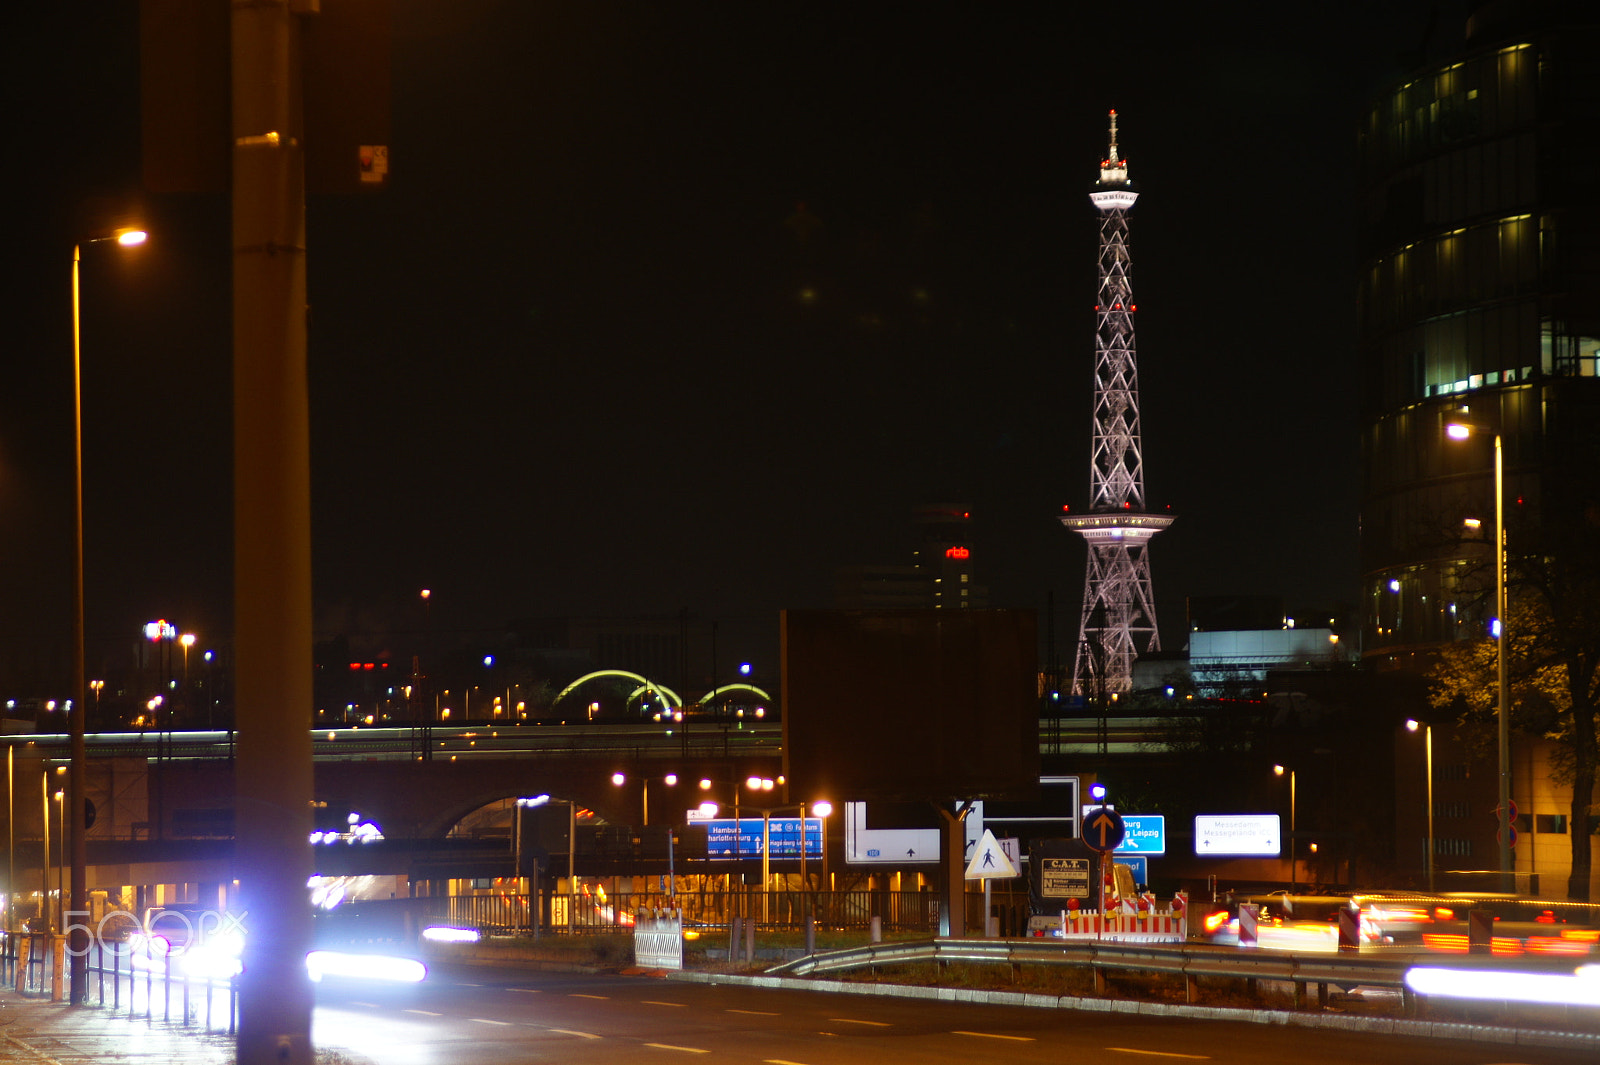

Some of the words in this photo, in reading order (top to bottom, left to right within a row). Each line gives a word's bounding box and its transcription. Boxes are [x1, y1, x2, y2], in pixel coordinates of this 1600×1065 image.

[946, 546, 969, 559] rbb
[1123, 820, 1141, 829] burg
[1214, 821, 1261, 829] Messedamm
[1132, 829, 1160, 838] Leipzig
[1051, 860, 1080, 868] C.A.T.
